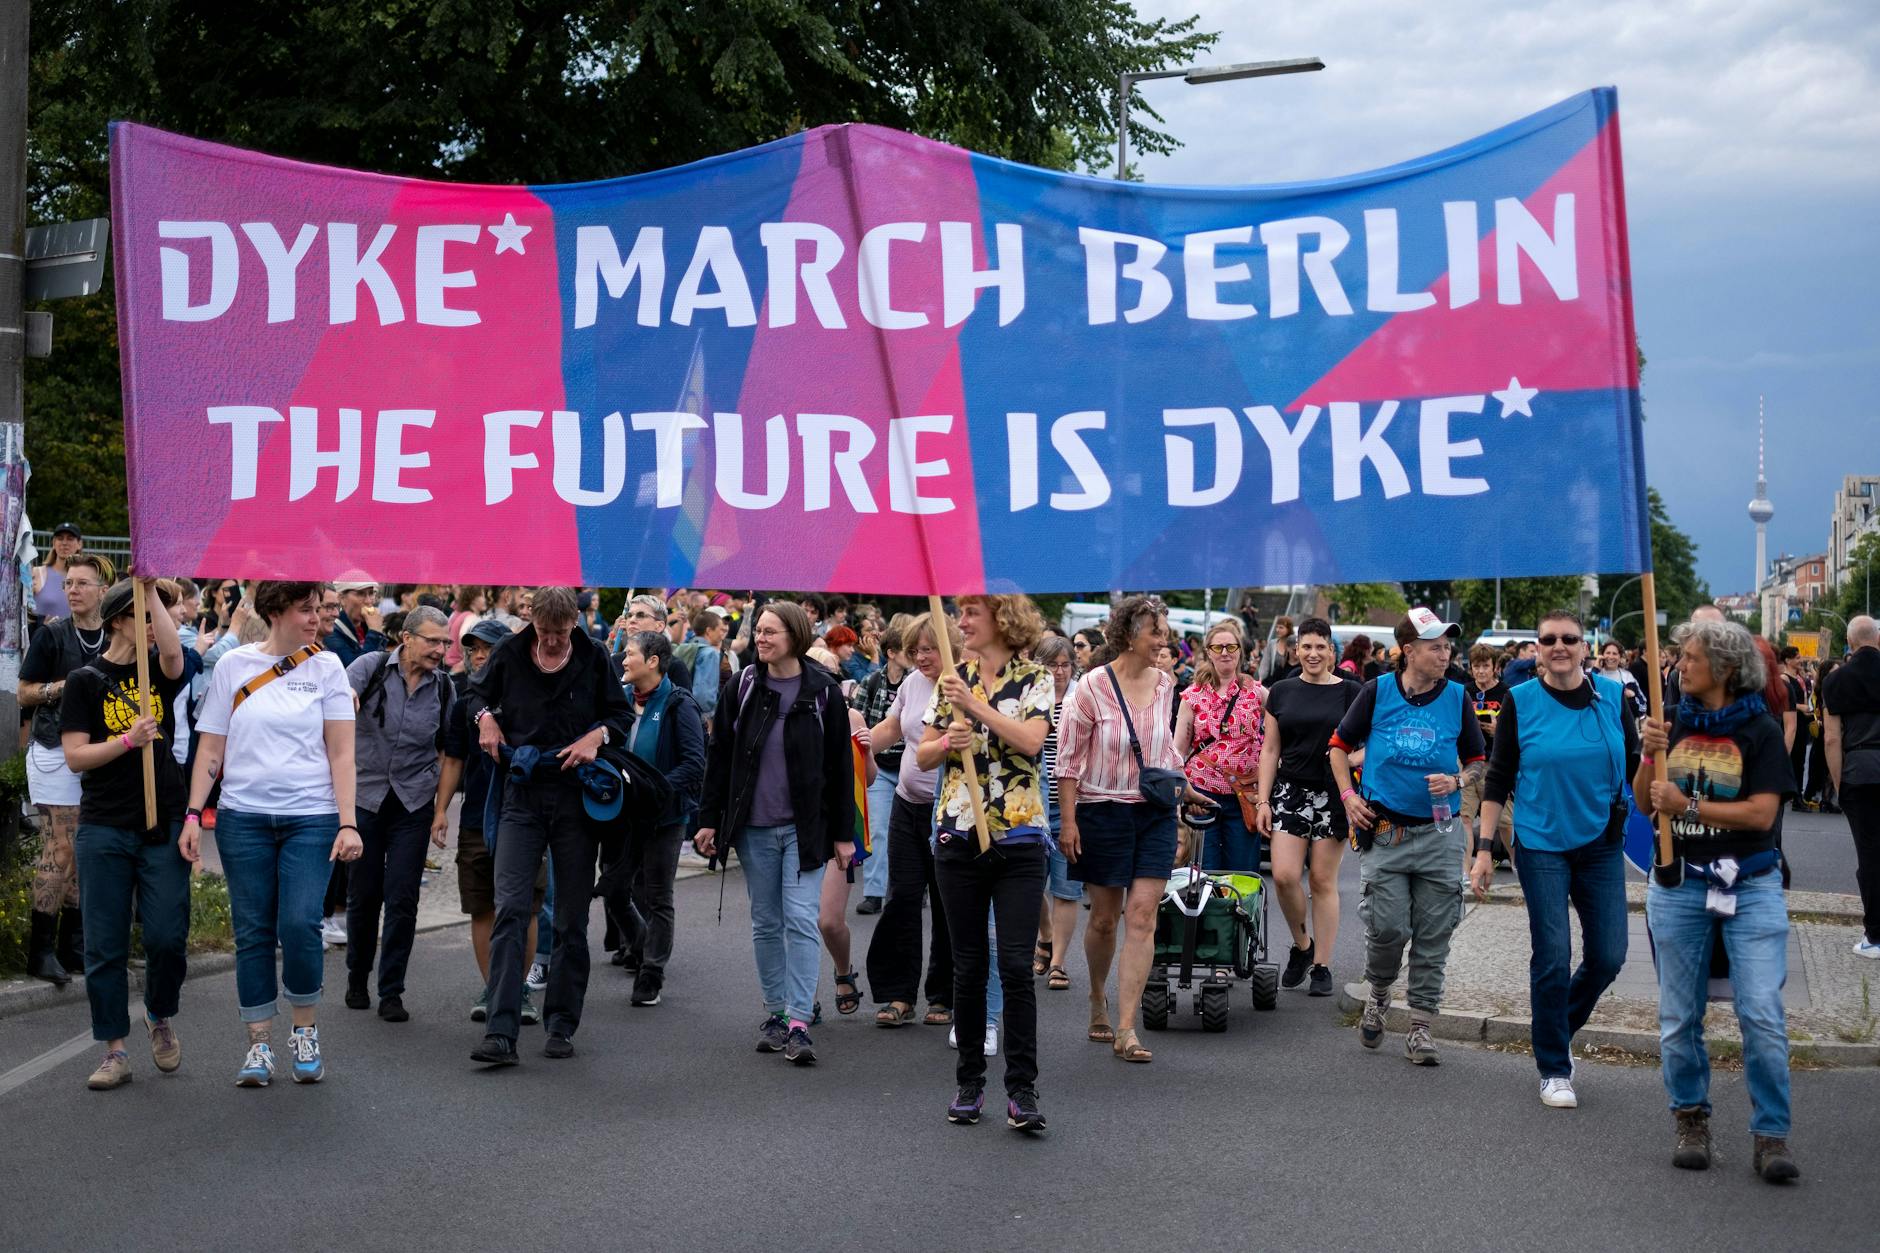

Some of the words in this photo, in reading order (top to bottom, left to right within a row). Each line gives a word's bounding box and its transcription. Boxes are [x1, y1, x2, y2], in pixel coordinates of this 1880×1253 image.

[574, 221, 1025, 330] MARCH
[1079, 192, 1579, 325] BERLIN
[207, 405, 436, 504] THE
[483, 410, 956, 515] FUTURE
[1007, 410, 1112, 512] IS
[1671, 820, 1705, 836] Was
